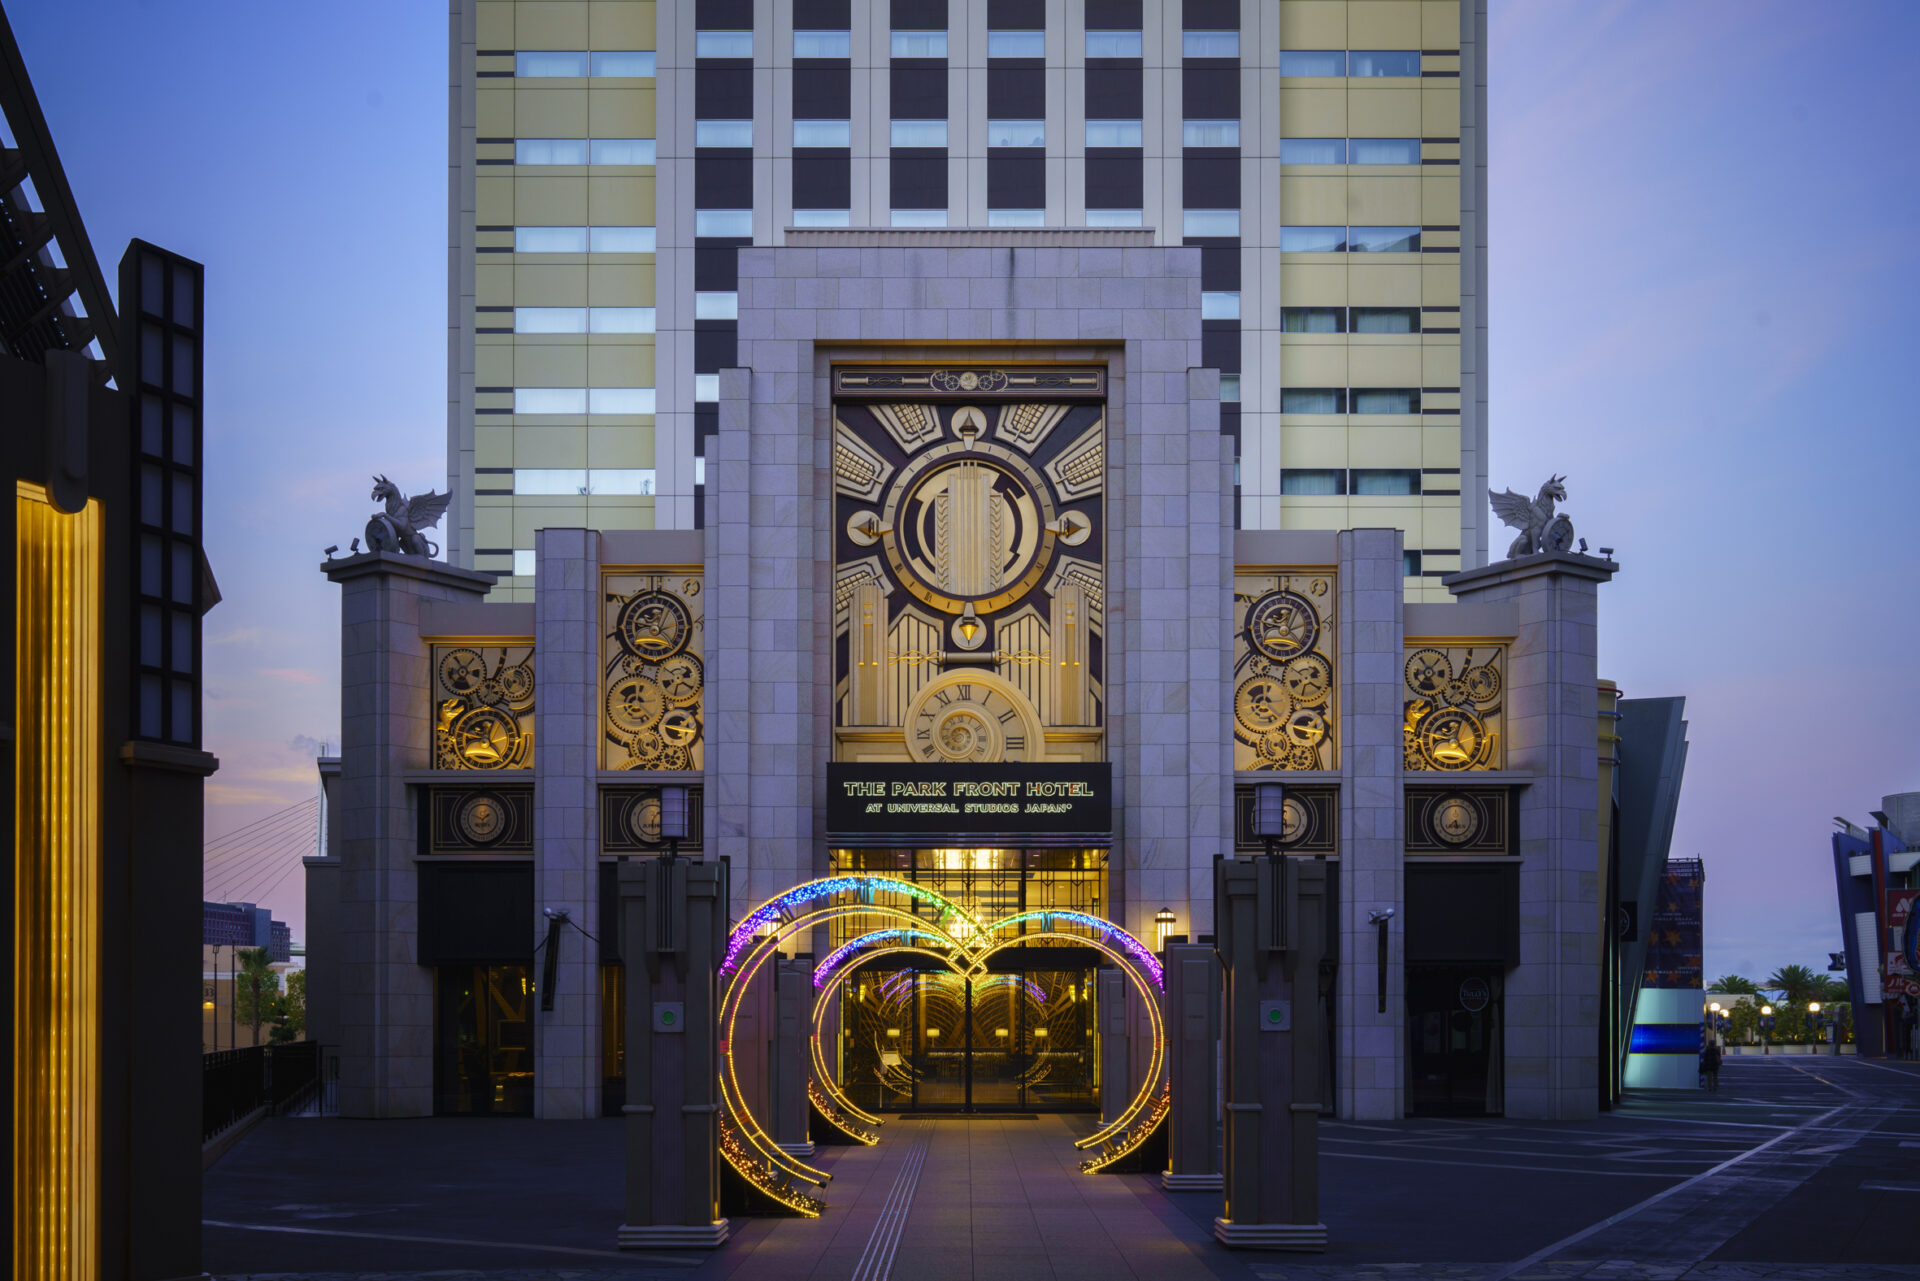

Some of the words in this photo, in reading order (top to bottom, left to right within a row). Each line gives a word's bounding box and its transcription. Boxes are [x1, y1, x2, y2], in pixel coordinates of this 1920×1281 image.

[844, 782, 886, 796] THE
[892, 782, 947, 796] PARK
[953, 782, 1020, 796] FRONT
[1026, 782, 1094, 796] HOTEL
[866, 803, 882, 813] AT
[887, 803, 959, 813] UNIVERSAL
[965, 803, 1019, 813] STUDIOS
